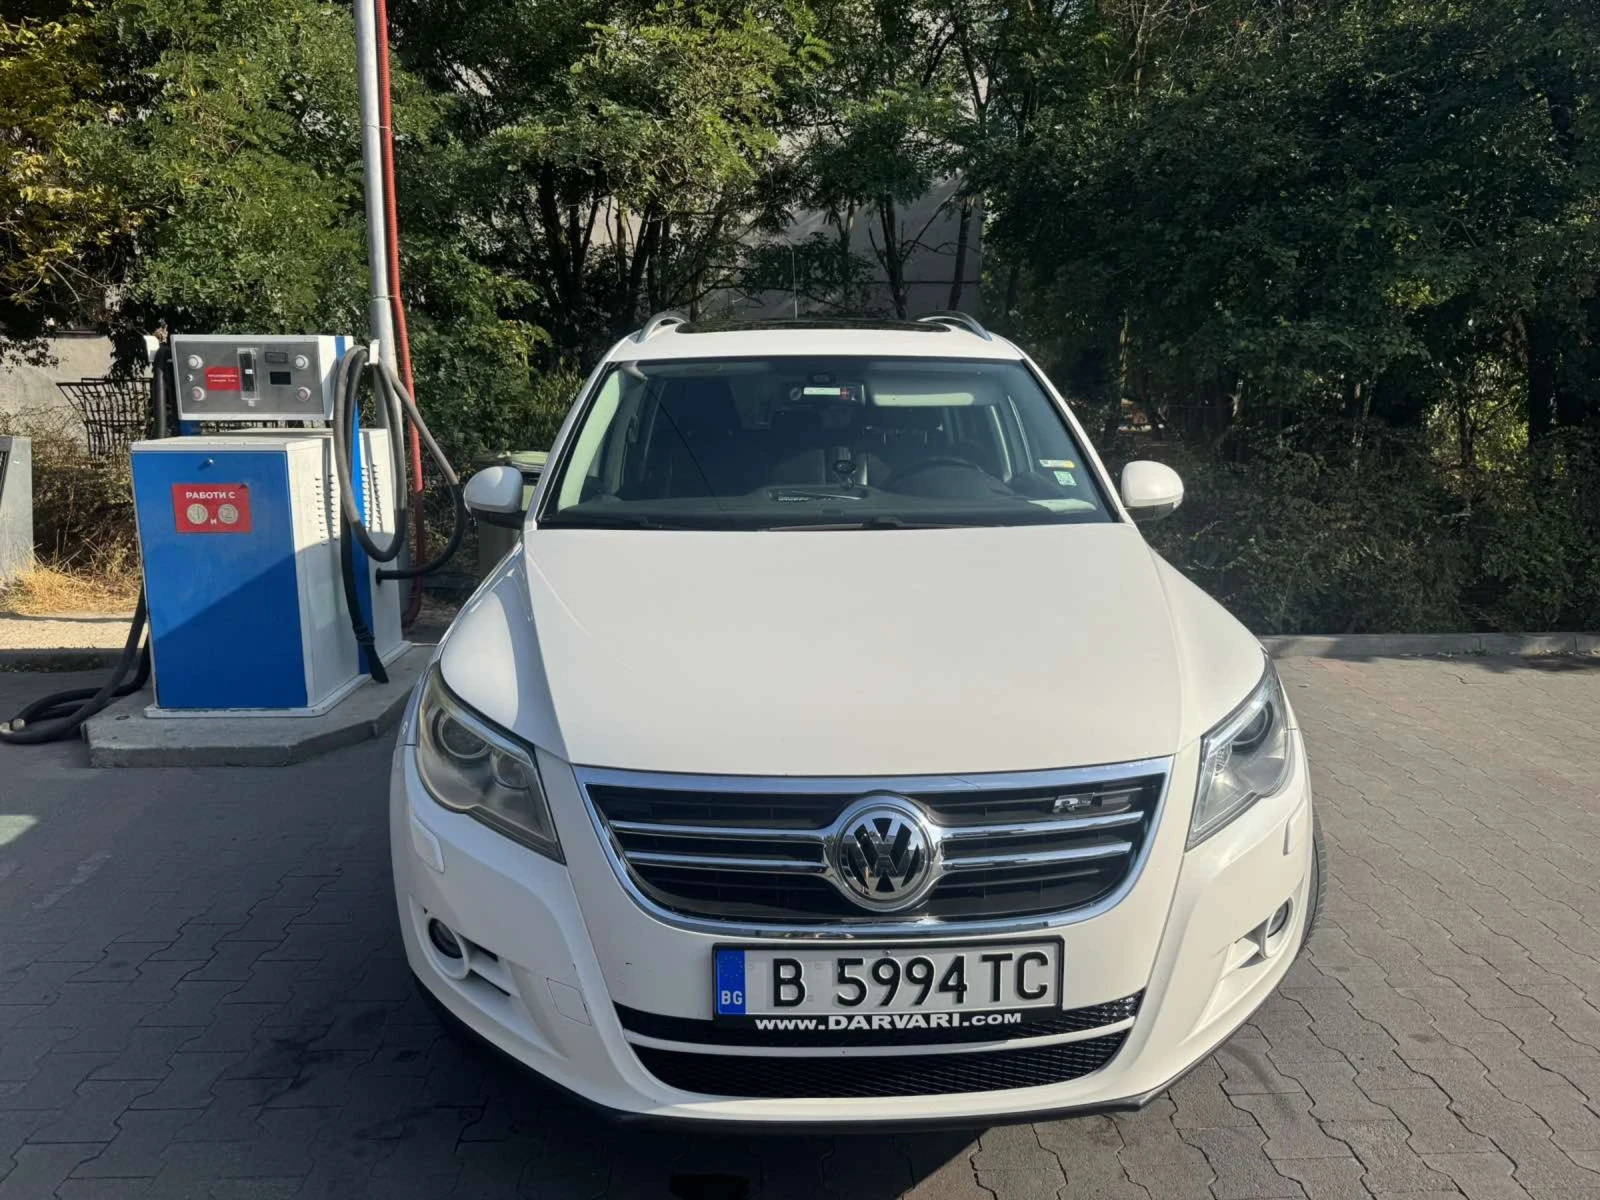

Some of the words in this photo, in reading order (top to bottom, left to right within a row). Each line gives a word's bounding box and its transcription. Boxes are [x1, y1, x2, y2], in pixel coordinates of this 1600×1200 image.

[185, 491, 227, 499] РАБОТИ
[228, 491, 236, 499] С
[772, 957, 806, 1008] B
[836, 954, 968, 1008] 5994
[980, 950, 1049, 1003] TC
[721, 990, 743, 1005] BG
